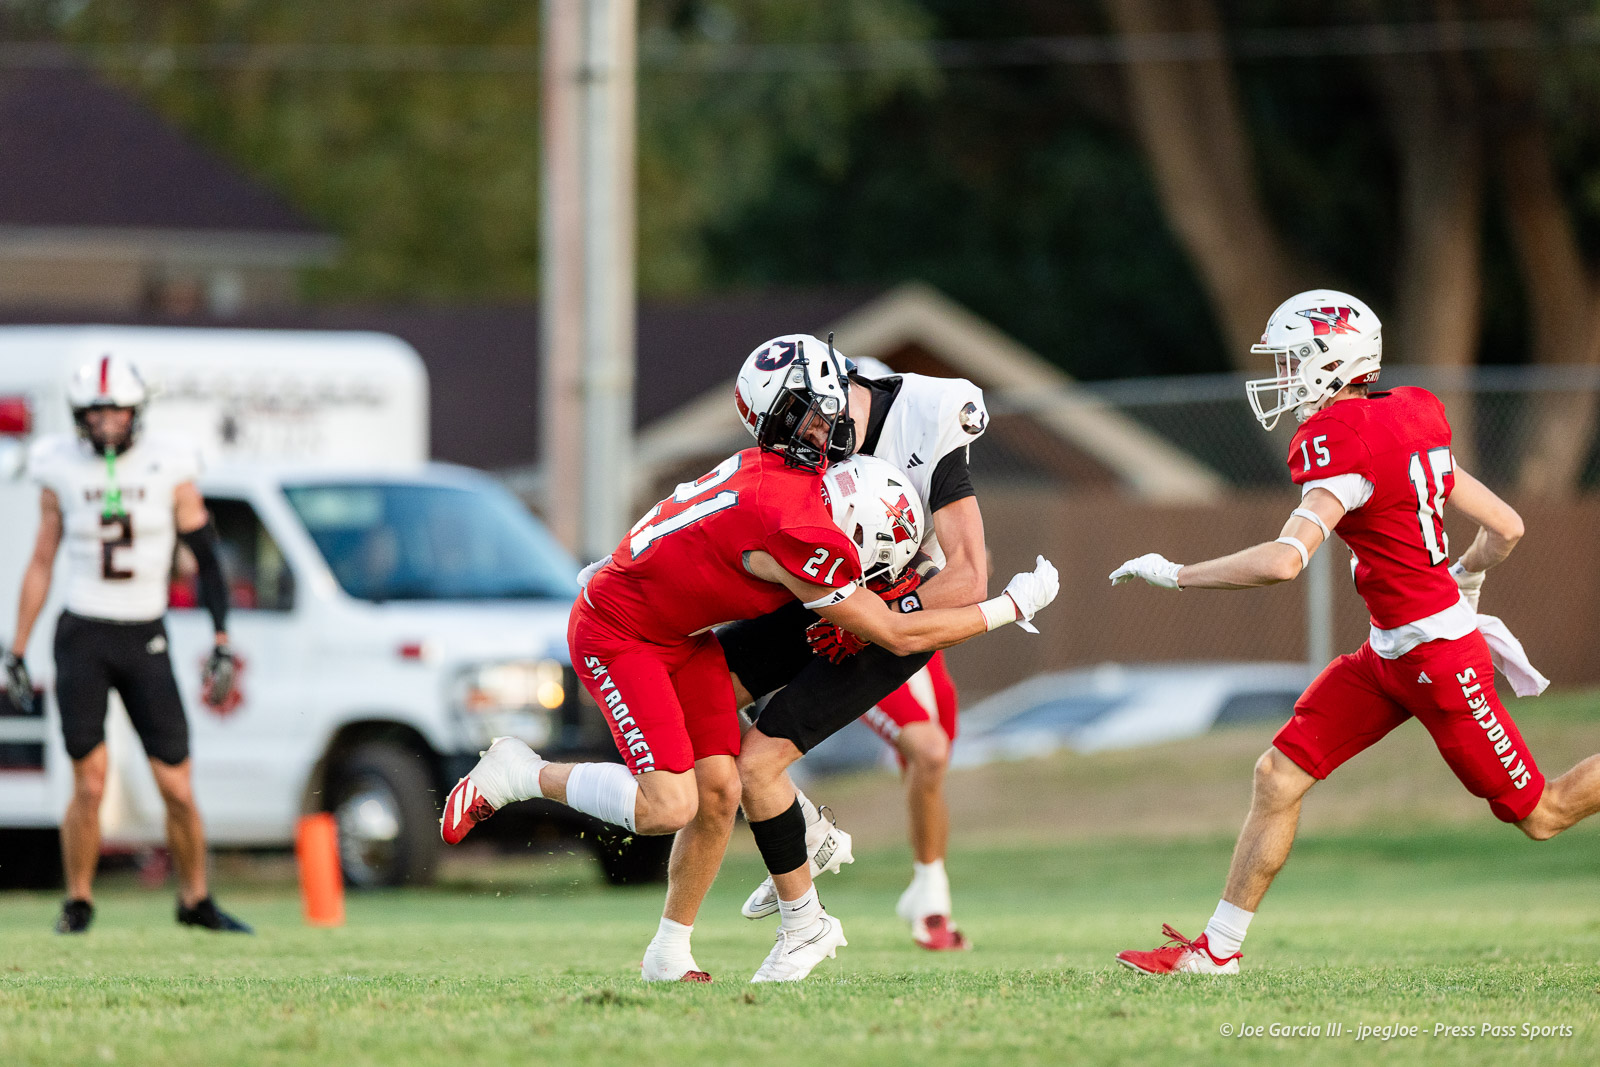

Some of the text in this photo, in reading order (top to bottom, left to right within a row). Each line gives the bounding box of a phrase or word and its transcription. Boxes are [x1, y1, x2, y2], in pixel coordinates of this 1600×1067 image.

[1300, 434, 1331, 472] 15
[101, 512, 134, 579] 2
[629, 453, 742, 561] 21
[1408, 446, 1454, 567] 15
[801, 547, 845, 585] 21
[1455, 667, 1532, 790] SKYROCKETS
